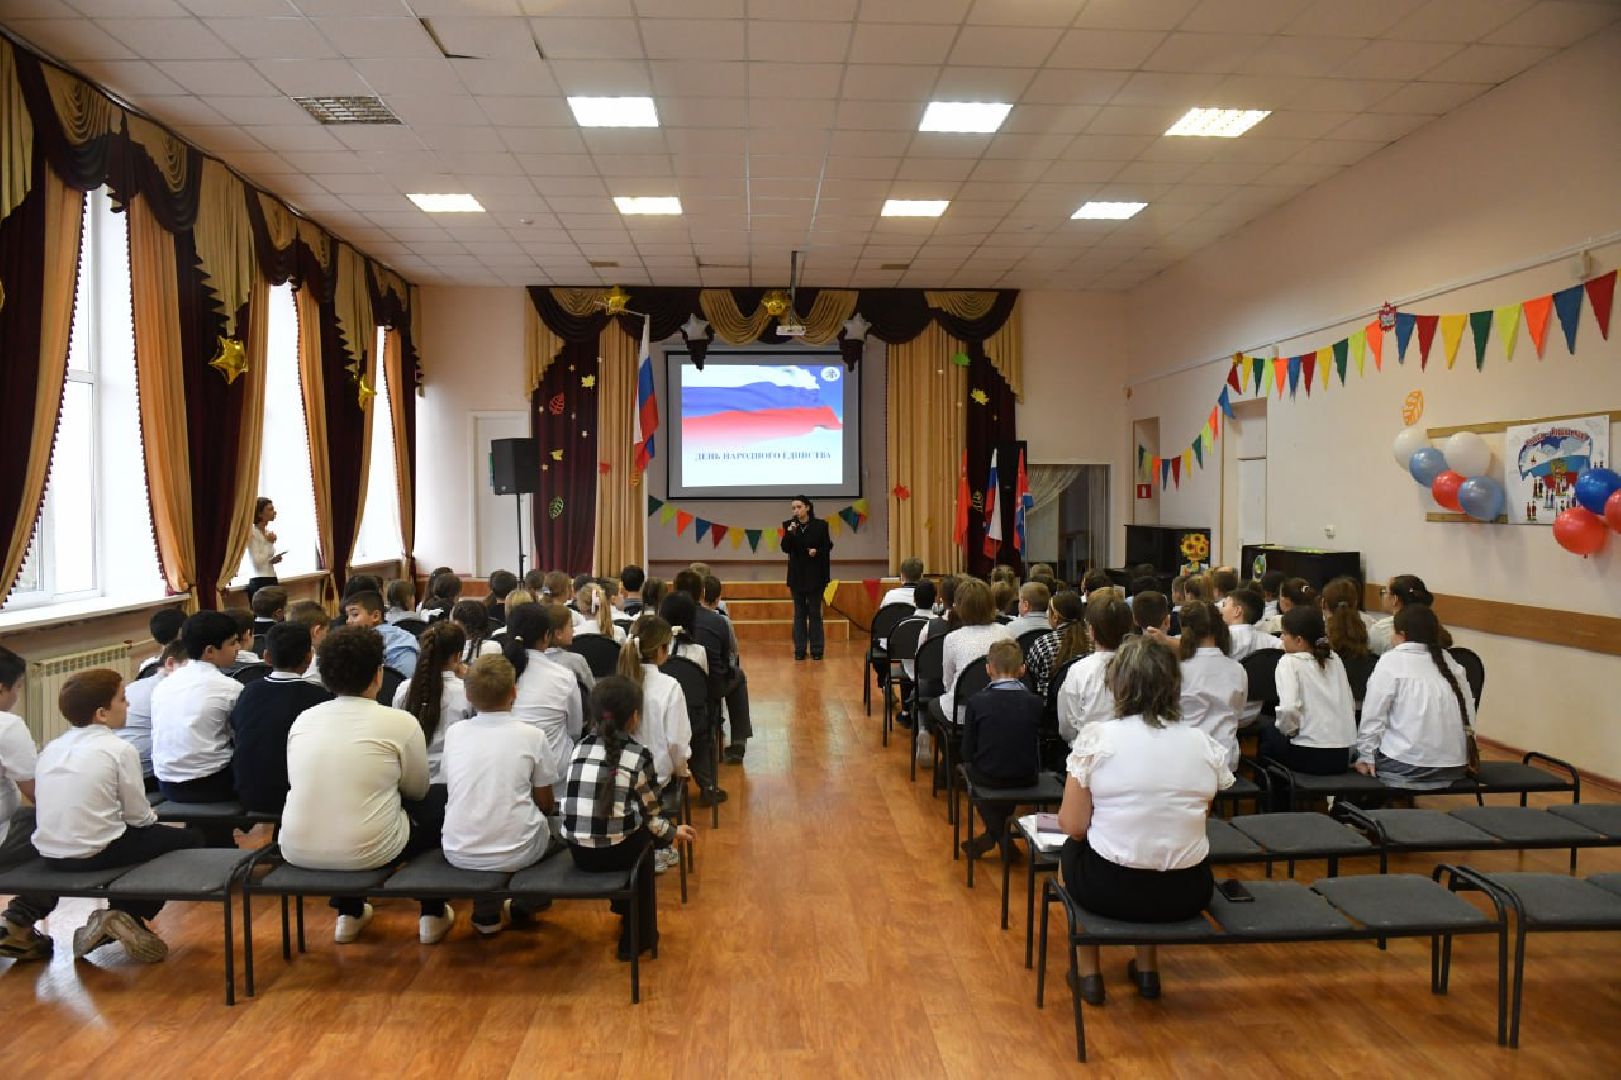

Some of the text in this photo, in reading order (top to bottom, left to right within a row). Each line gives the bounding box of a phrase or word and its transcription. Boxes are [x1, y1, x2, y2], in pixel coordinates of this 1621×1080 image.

[696, 451, 831, 461] ДЕНЬ НАРОДНОГО ЕДИНСТВА
